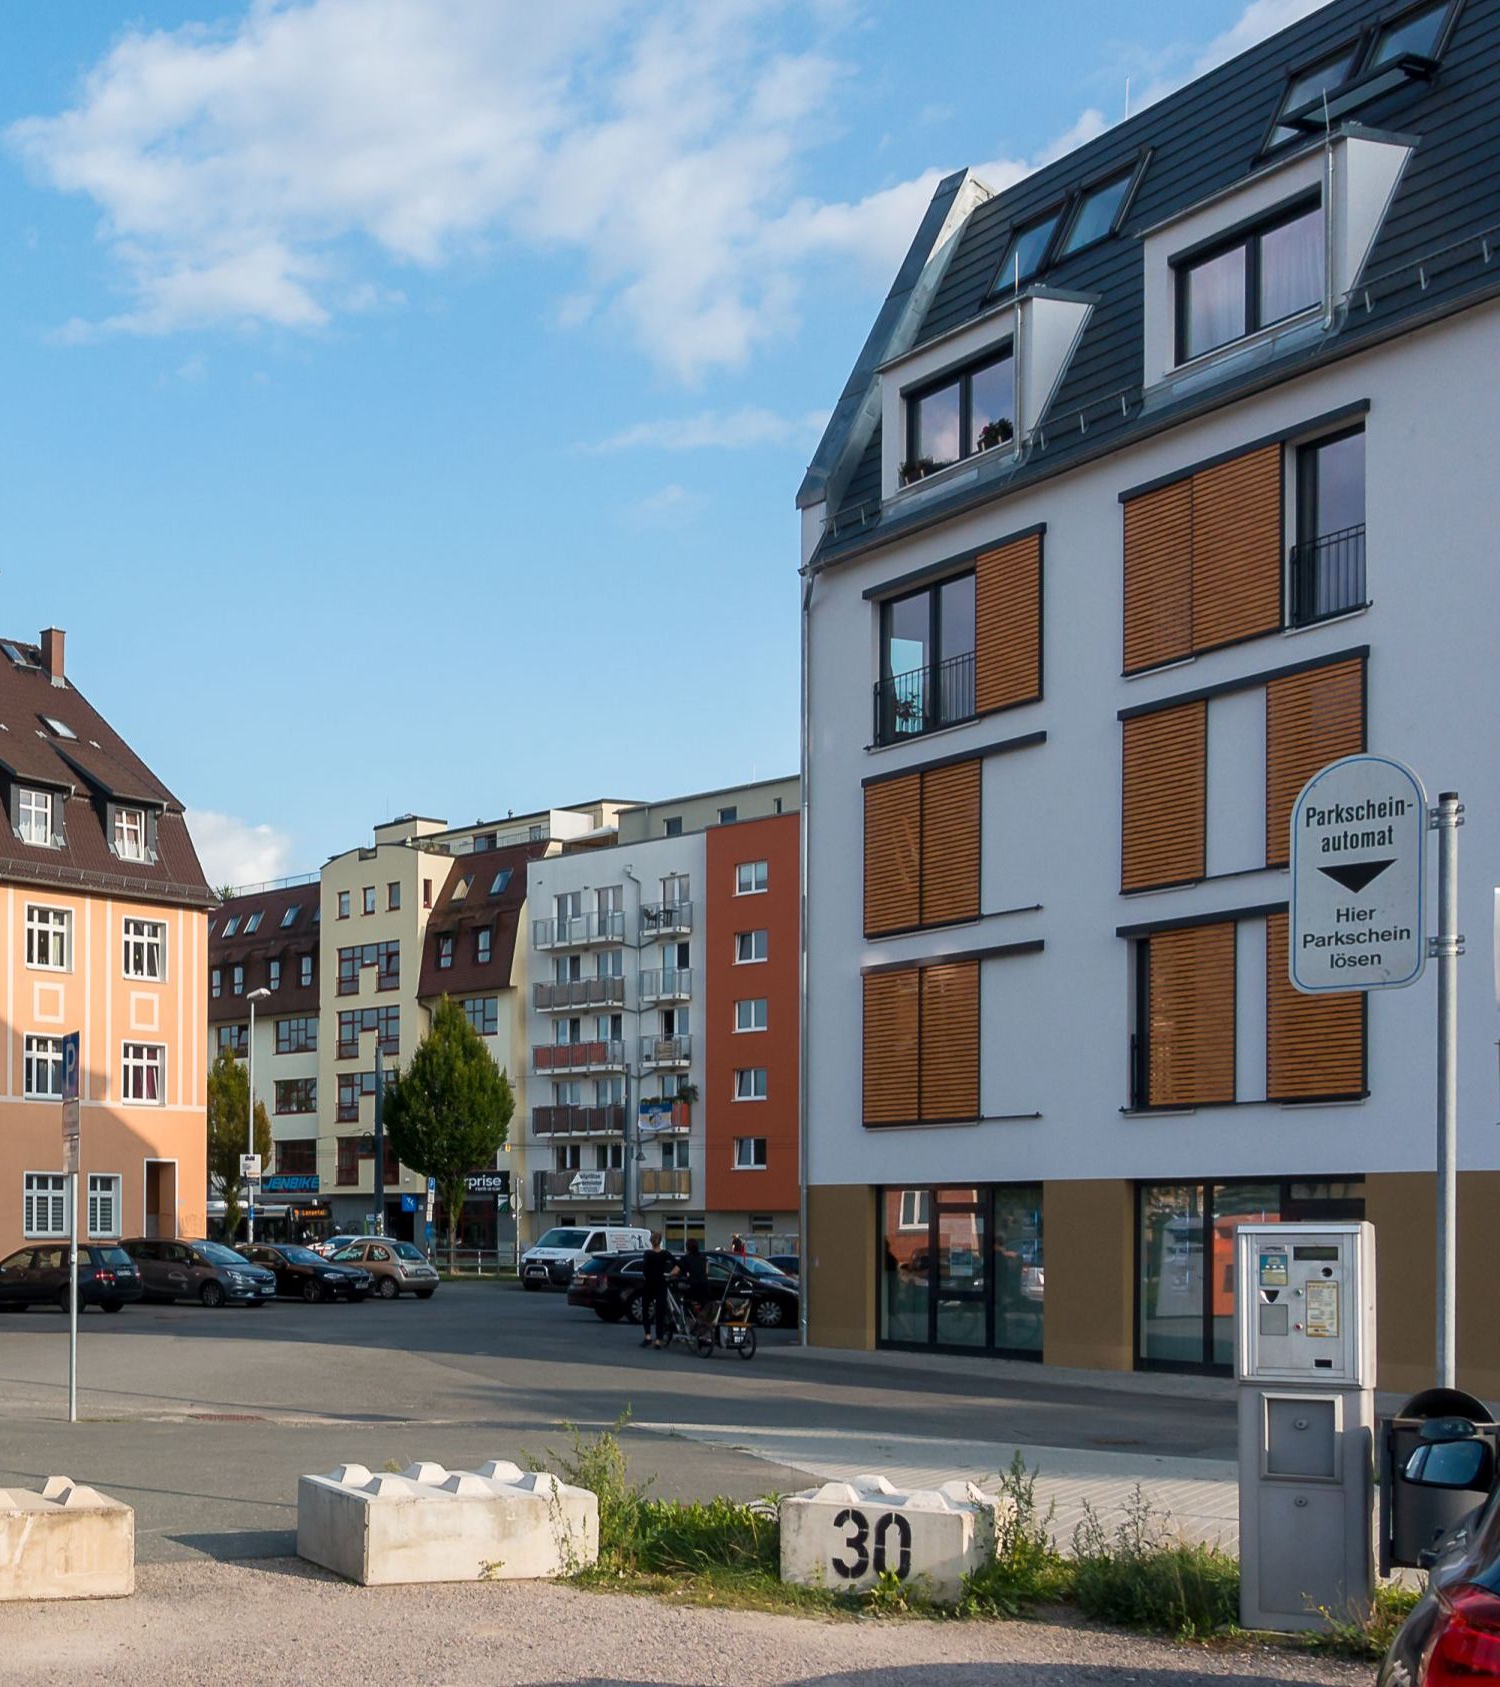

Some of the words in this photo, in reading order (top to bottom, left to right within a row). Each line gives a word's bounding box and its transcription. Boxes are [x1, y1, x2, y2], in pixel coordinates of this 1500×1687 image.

[1305, 797, 1414, 828] Parkschein-
[1321, 825, 1394, 853] automat
[1335, 907, 1377, 924] Hier
[1302, 926, 1411, 949] Parkschein
[1329, 952, 1382, 969] lösen
[66, 1042, 76, 1092] P
[263, 1176, 319, 1190] JENBIKE
[832, 1508, 912, 1579] 30
